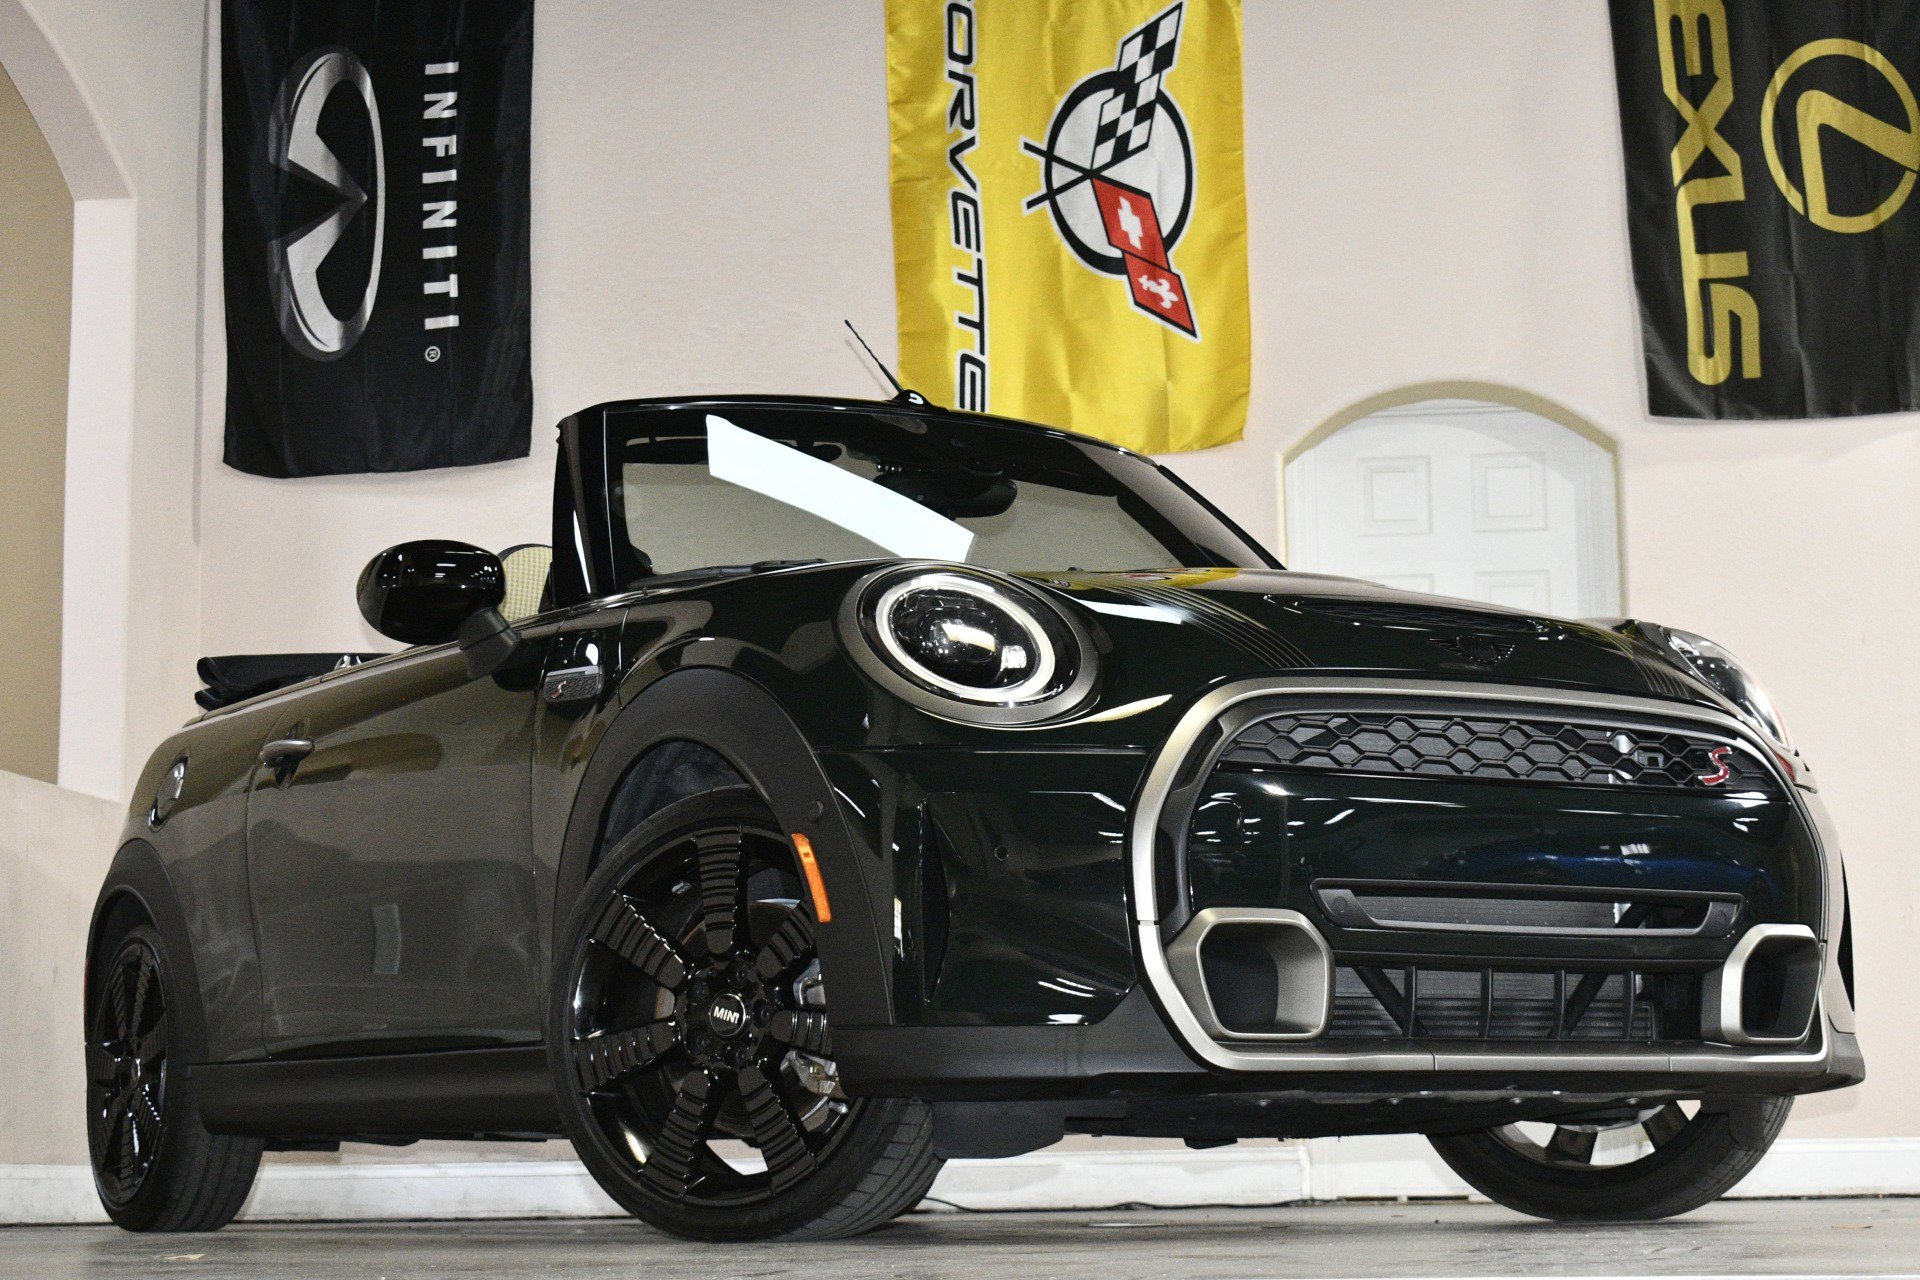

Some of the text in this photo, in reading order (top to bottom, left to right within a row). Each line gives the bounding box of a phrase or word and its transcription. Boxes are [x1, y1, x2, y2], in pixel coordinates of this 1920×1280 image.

[422, 61, 460, 330] INFINITI
[947, 0, 987, 412] ORVETTE
[1653, 0, 1762, 386] EXUS
[1697, 746, 1733, 786] S
[713, 1005, 740, 1025] MINI
